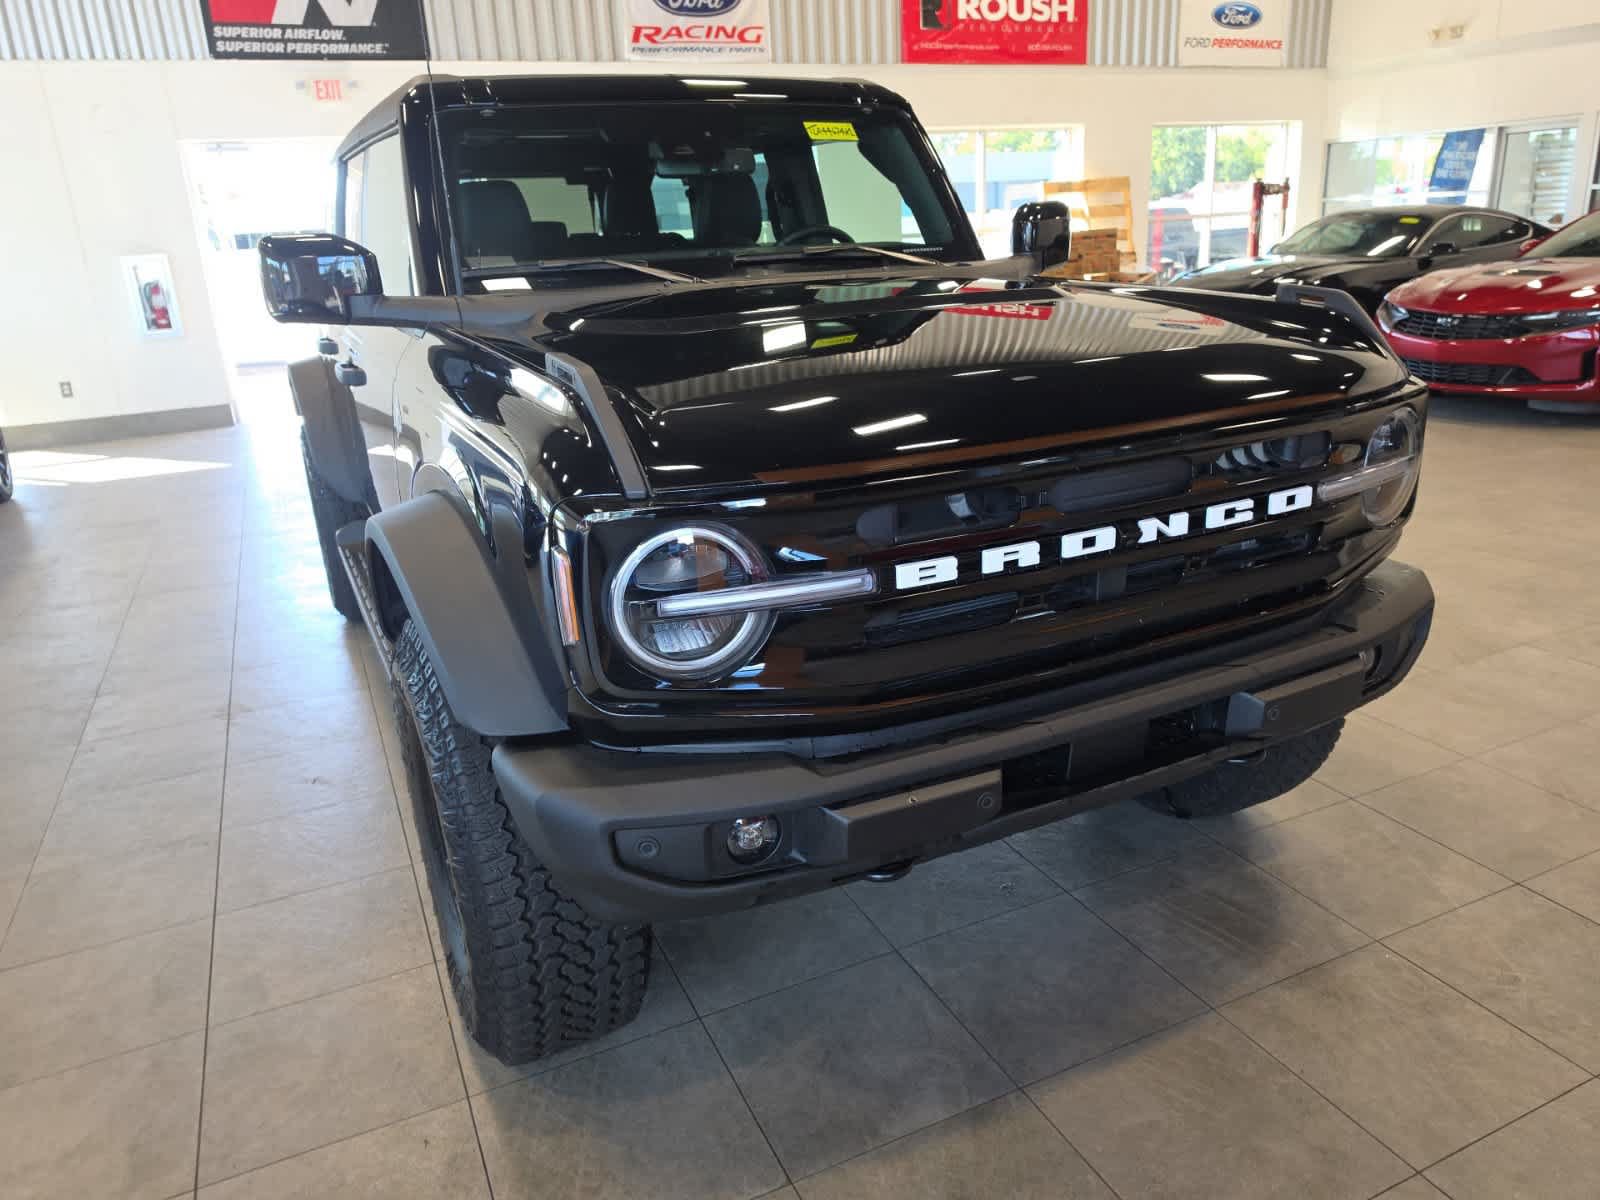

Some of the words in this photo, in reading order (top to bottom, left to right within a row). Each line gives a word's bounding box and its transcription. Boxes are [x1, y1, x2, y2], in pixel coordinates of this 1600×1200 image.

[957, 0, 1075, 22] ROUSH
[1220, 5, 1253, 24] Ford
[213, 26, 282, 39] SUPERIOR
[284, 28, 346, 41] AIRFLOW.
[631, 25, 764, 44] RACING
[1184, 37, 1211, 48] FORD
[1211, 37, 1284, 49] PERFORMANCE
[216, 40, 285, 53] SUPERIOR
[632, 46, 726, 54] PERFORMANCE
[313, 79, 342, 101] EXIT
[895, 485, 1313, 590] BRONCO
